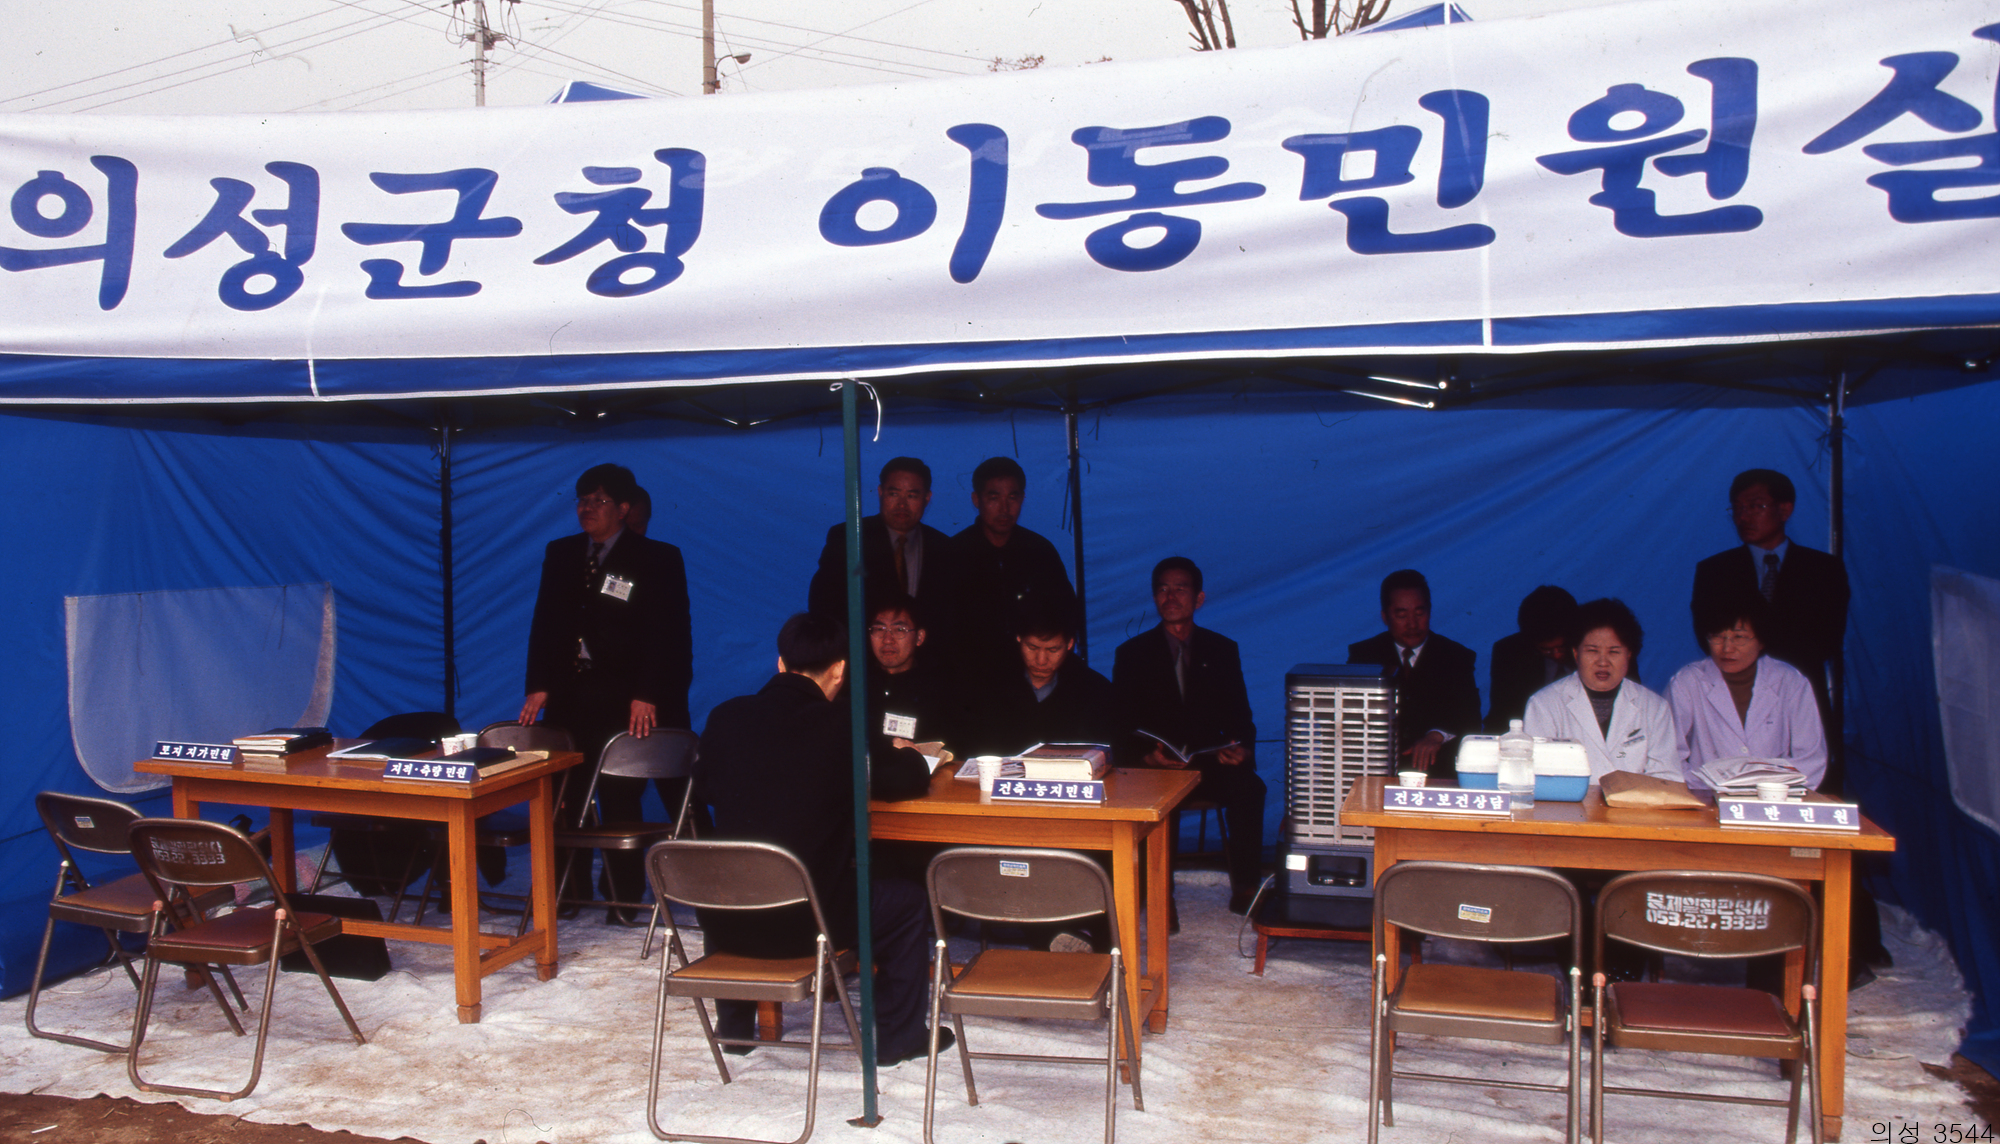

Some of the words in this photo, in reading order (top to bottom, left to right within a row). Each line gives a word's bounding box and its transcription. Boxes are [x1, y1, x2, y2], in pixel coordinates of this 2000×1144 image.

[0, 147, 705, 311] 의성군청
[820, 29, 2000, 282] 이동민원실
[159, 745, 183, 758] 토지
[186, 746, 231, 761] 지가민원
[446, 766, 467, 779] 민원
